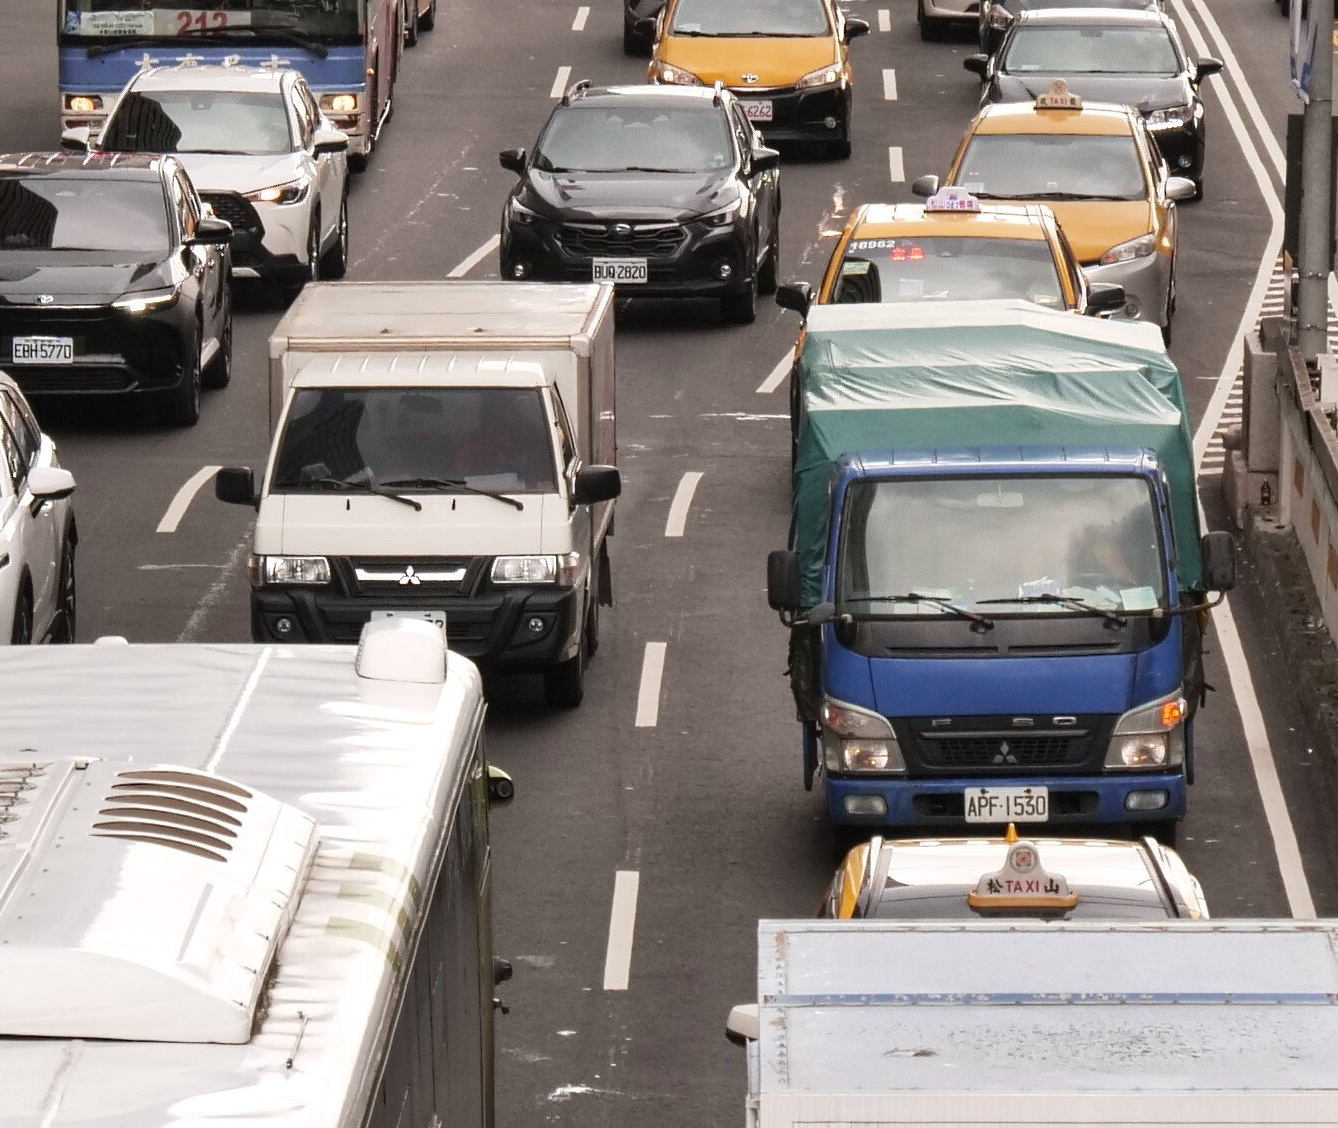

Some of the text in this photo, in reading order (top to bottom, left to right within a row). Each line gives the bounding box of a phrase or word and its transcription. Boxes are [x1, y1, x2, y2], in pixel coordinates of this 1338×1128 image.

[176, 10, 229, 36] 212
[1050, 97, 1069, 105] TAXI
[593, 264, 646, 280] BUQ-2820
[14, 342, 72, 360] EBH-5770
[967, 794, 1047, 817] APF-1530
[987, 878, 1060, 895] 松 TAXI 山
